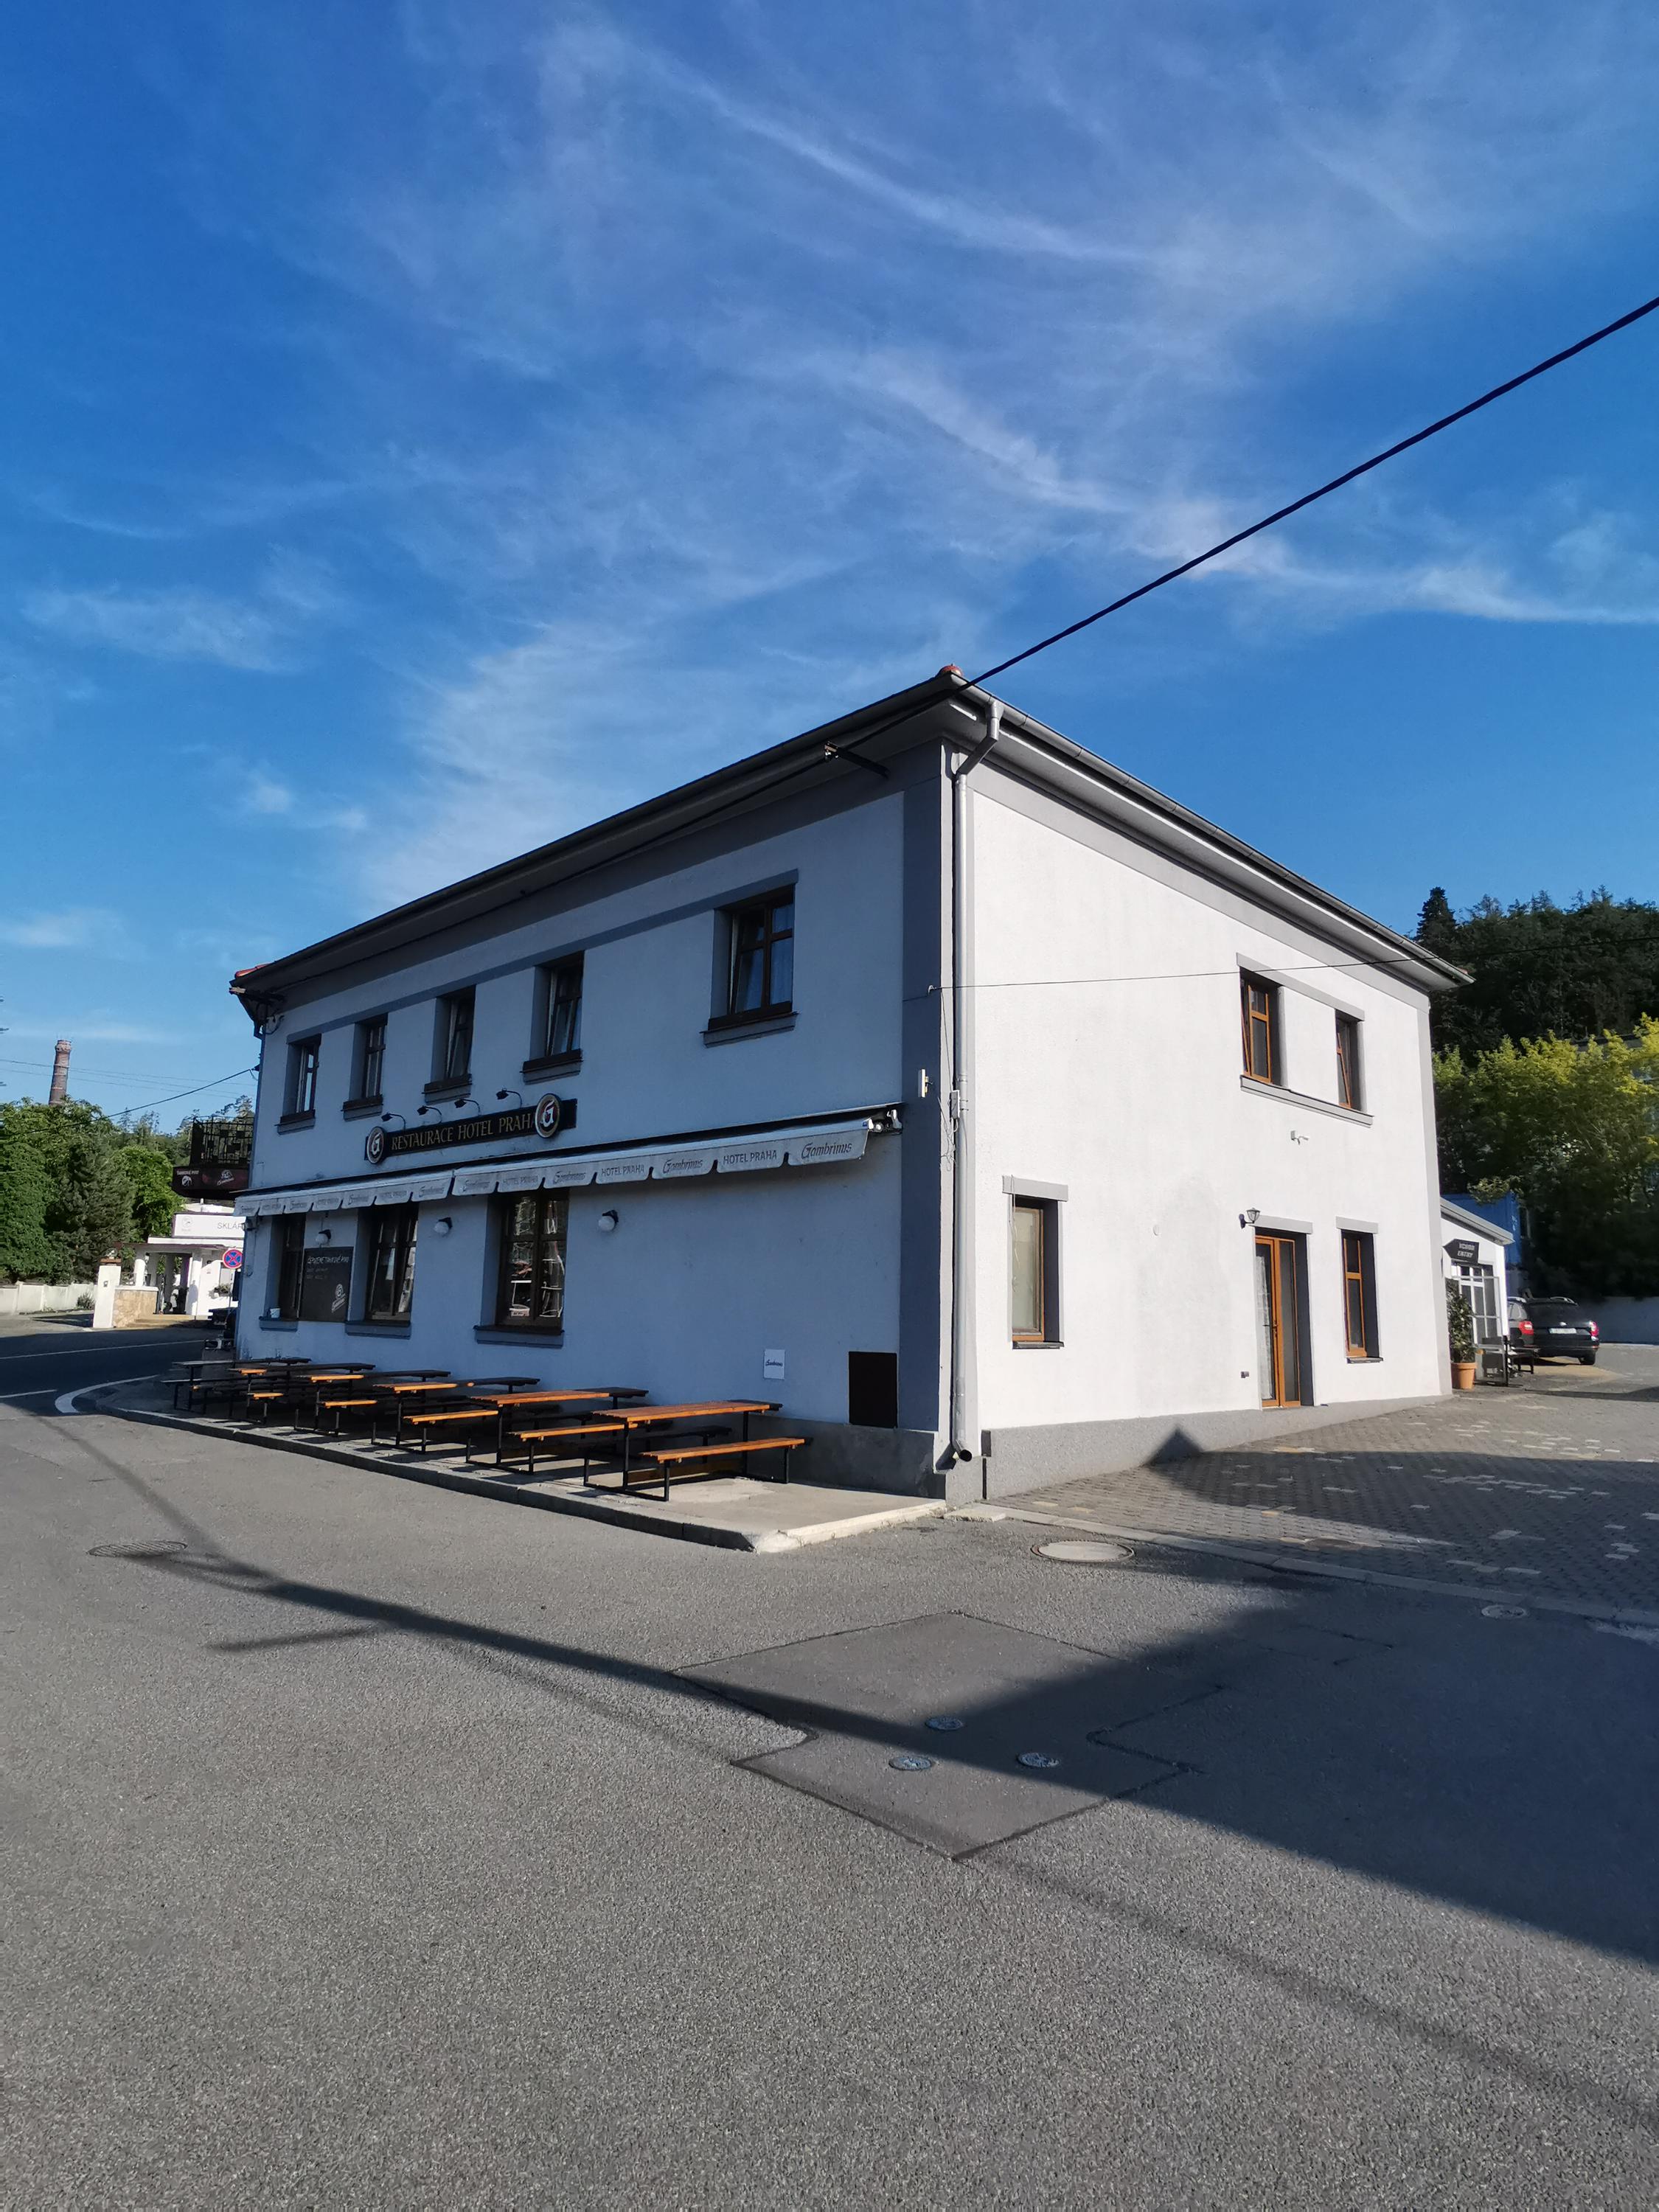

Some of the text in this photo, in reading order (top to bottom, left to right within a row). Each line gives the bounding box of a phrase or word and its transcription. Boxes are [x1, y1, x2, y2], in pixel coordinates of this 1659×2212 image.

[392, 1127, 454, 1151] RESTAURACE
[457, 1119, 494, 1141] HOTEL
[723, 1150, 777, 1165] HOTEL PRAHA
[801, 1142, 852, 1160] Gambrinus
[601, 1166, 623, 1177] HOTEL
[663, 1158, 703, 1174] Gambrinus
